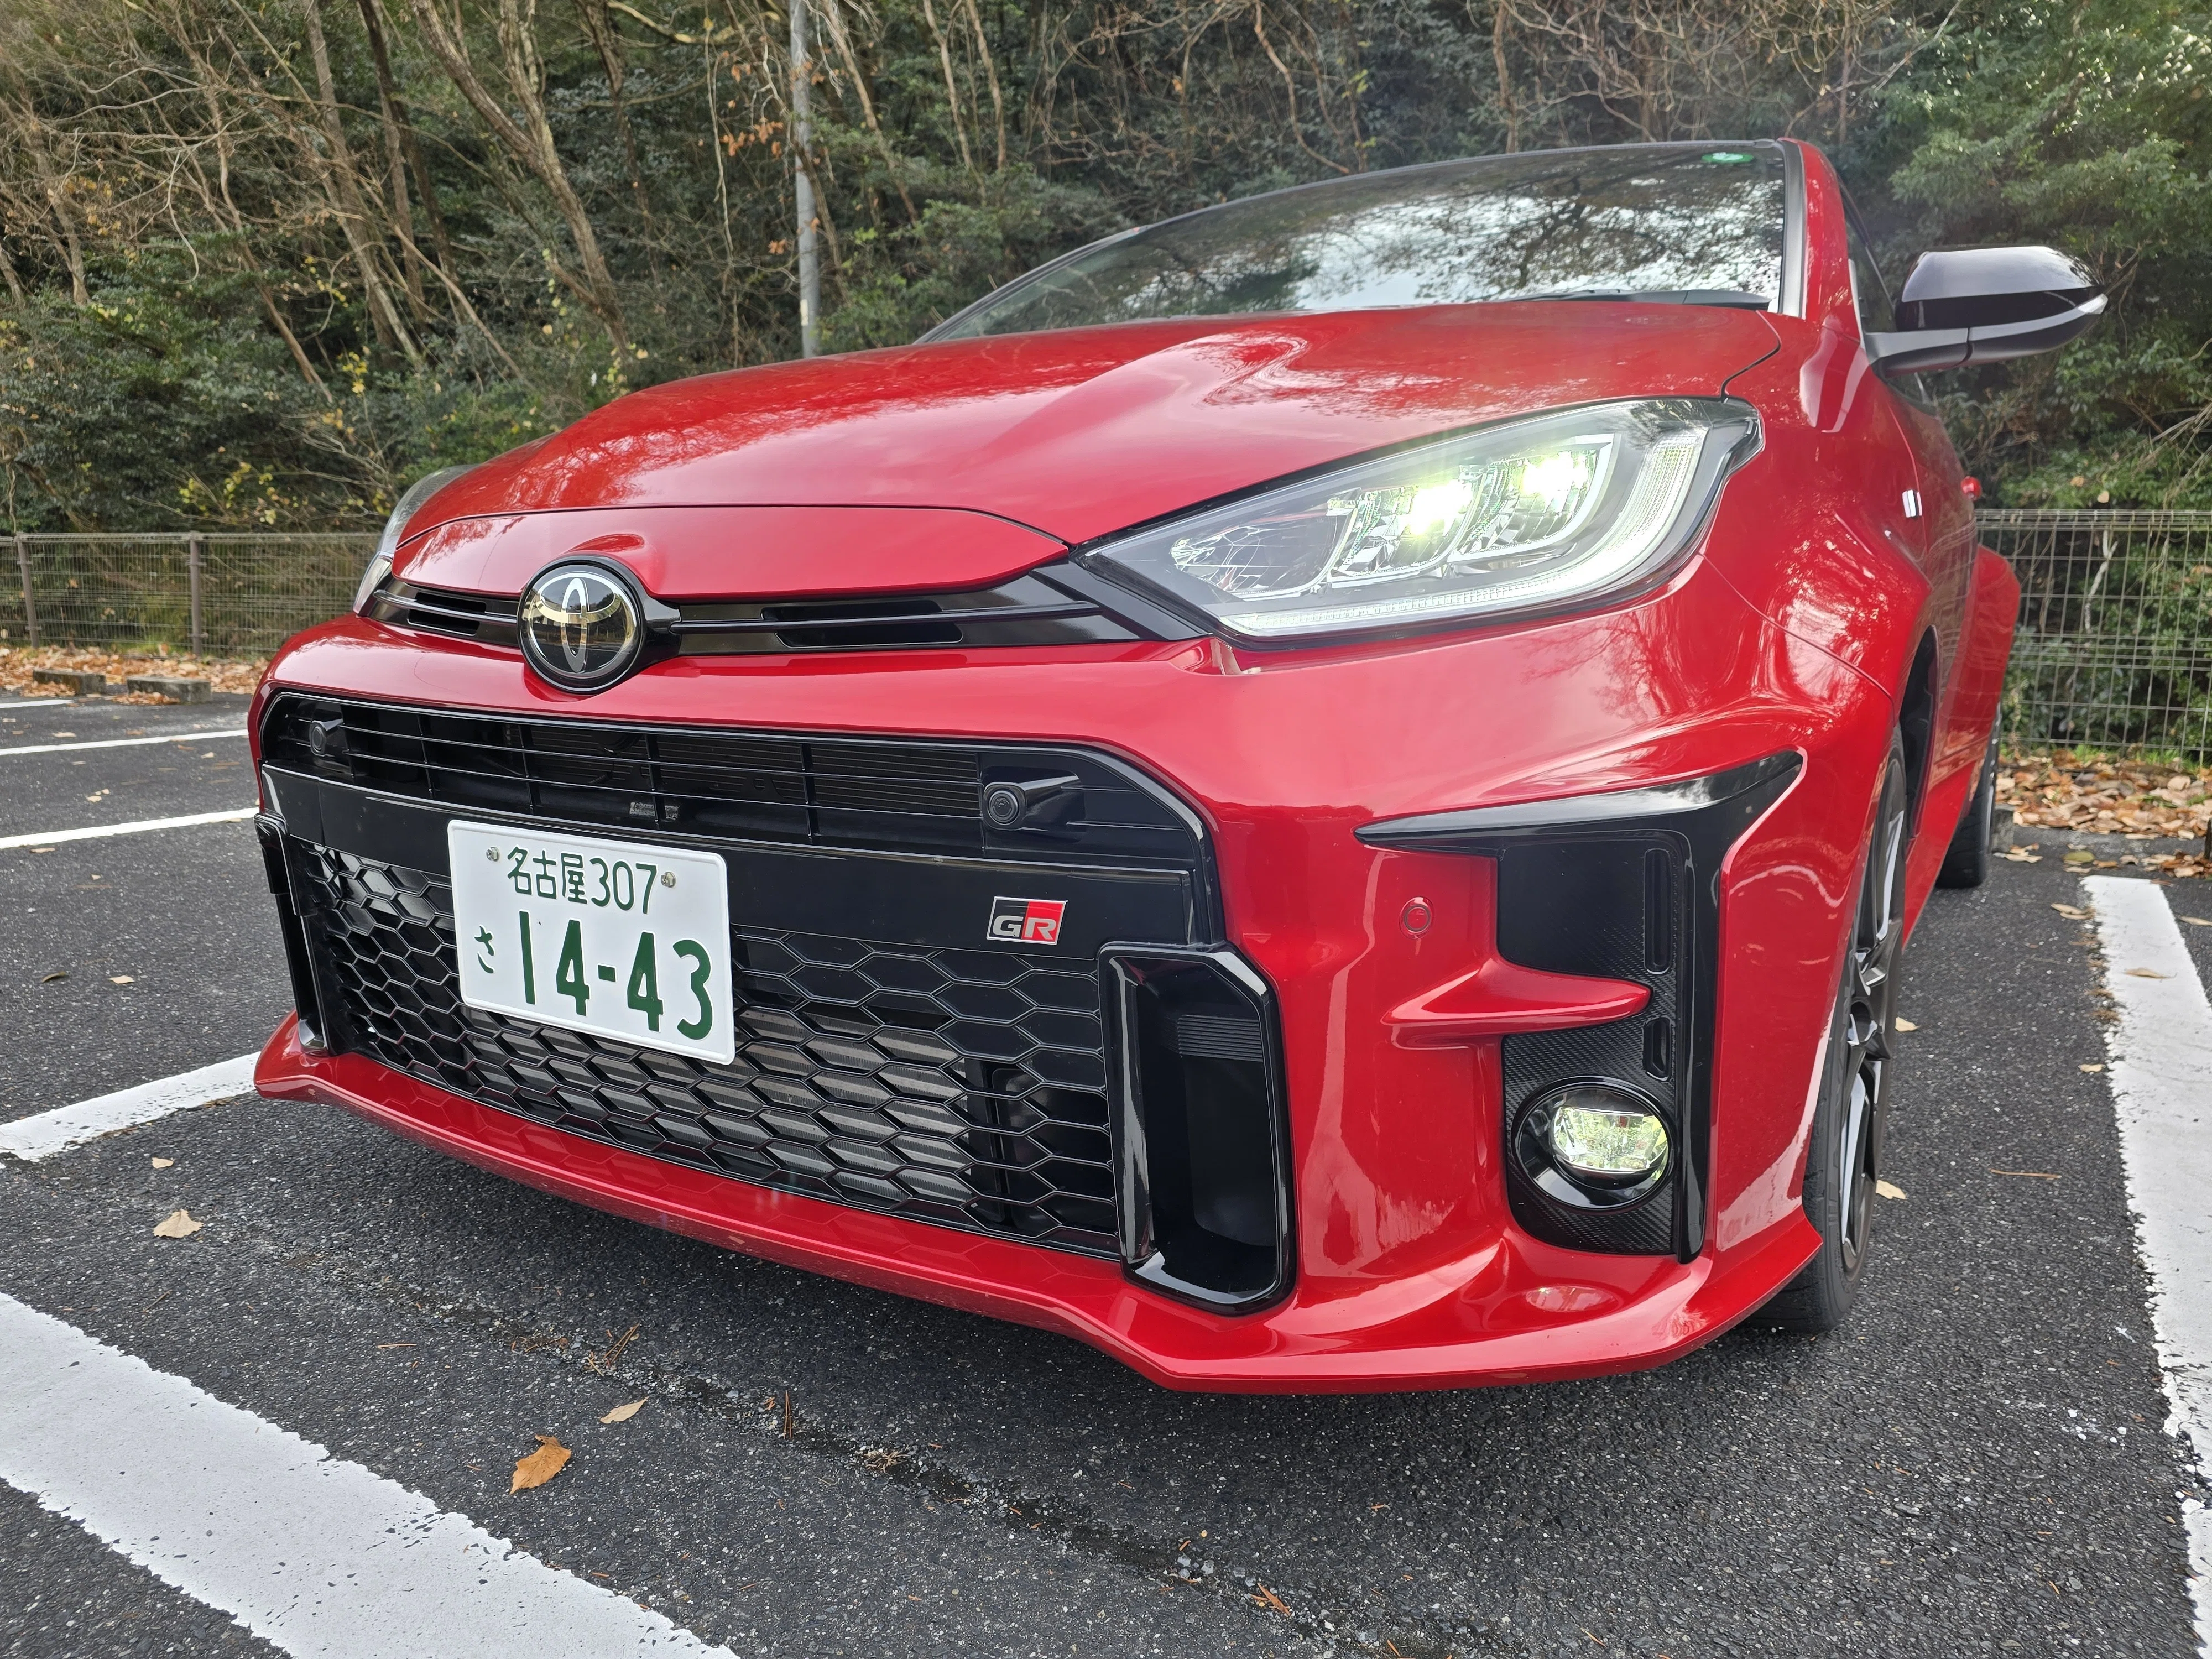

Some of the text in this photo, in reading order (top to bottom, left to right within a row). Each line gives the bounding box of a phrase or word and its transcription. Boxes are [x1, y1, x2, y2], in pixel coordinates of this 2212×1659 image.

[993, 915, 1057, 940] GR
[474, 911, 713, 1040] さ 14-43
